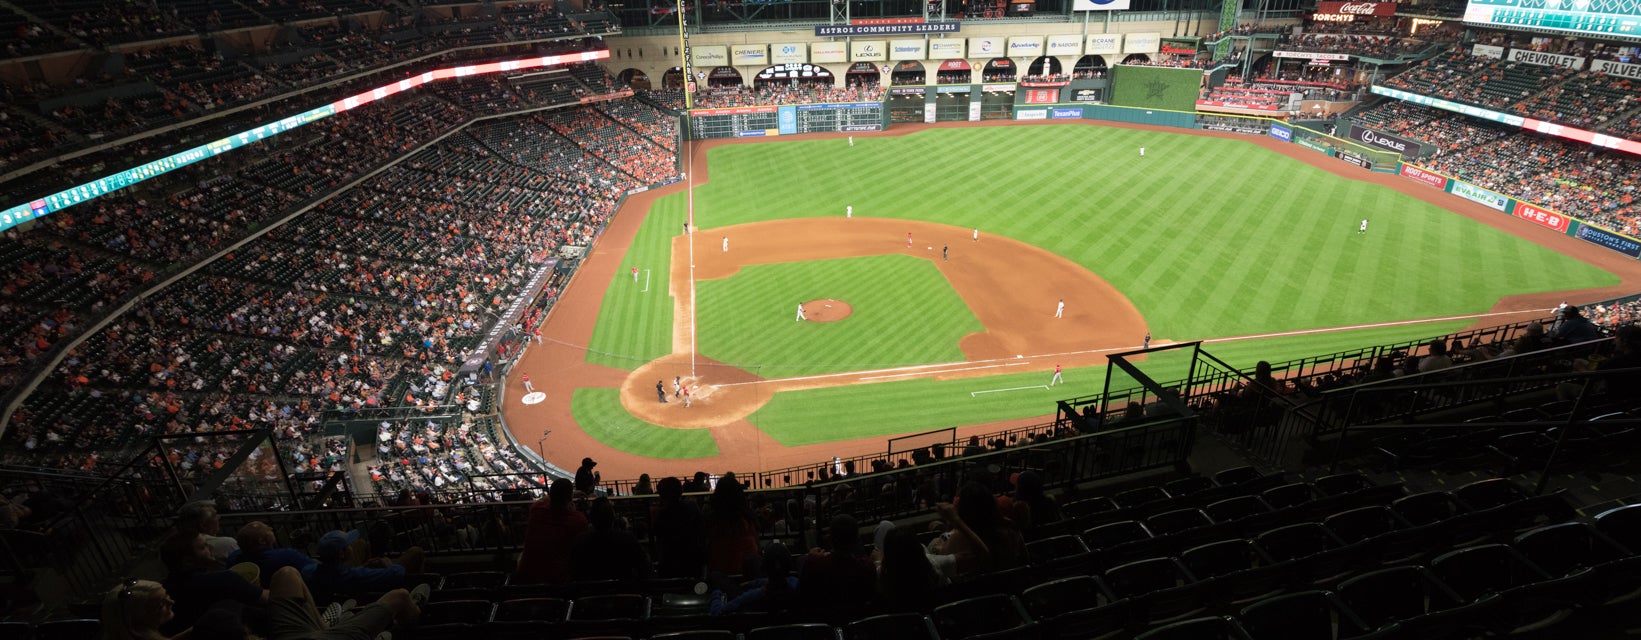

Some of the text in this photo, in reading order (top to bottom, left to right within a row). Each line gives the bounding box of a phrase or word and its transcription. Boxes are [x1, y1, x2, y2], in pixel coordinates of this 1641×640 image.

[1340, 2, 1377, 15] Coca-Cola
[857, 25, 913, 33] COMMUNITY
[1515, 50, 1577, 68] CHEVROLET
[1054, 109, 1080, 117] TexanPlus
[1271, 127, 1290, 139] GEICO
[1374, 136, 1406, 151] LEXUS
[1405, 166, 1421, 176] ROOT
[1421, 172, 1442, 184] SPORTS
[1455, 186, 1487, 200] EVA AIR
[1583, 227, 1639, 250] HOUSTON'S FIRST
